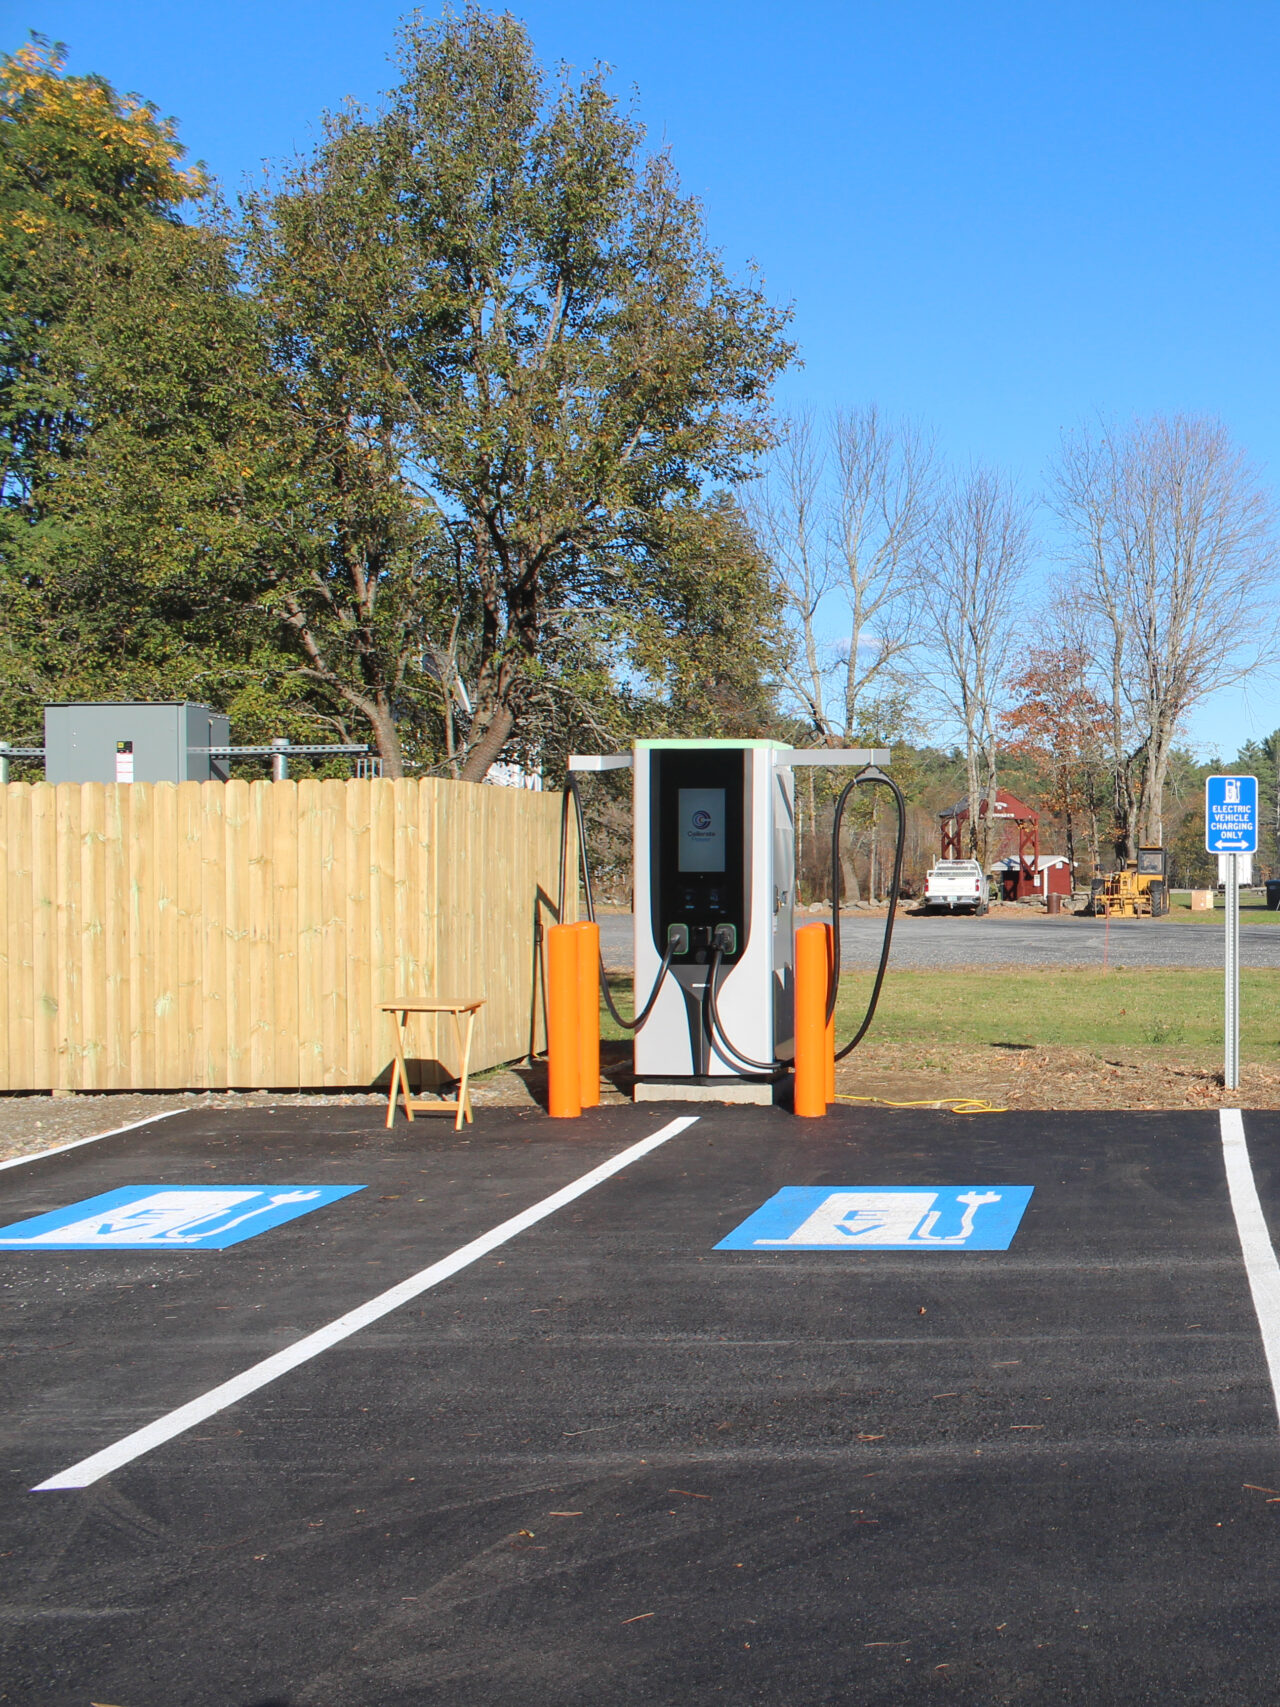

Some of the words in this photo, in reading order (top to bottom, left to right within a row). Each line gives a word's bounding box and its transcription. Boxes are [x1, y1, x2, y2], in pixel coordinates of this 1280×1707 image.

[1212, 805, 1252, 813] ELECTRIC
[1214, 813, 1250, 822] VEHICLE
[1210, 822, 1253, 831] CHARGING
[1220, 831, 1243, 839] ONLY
